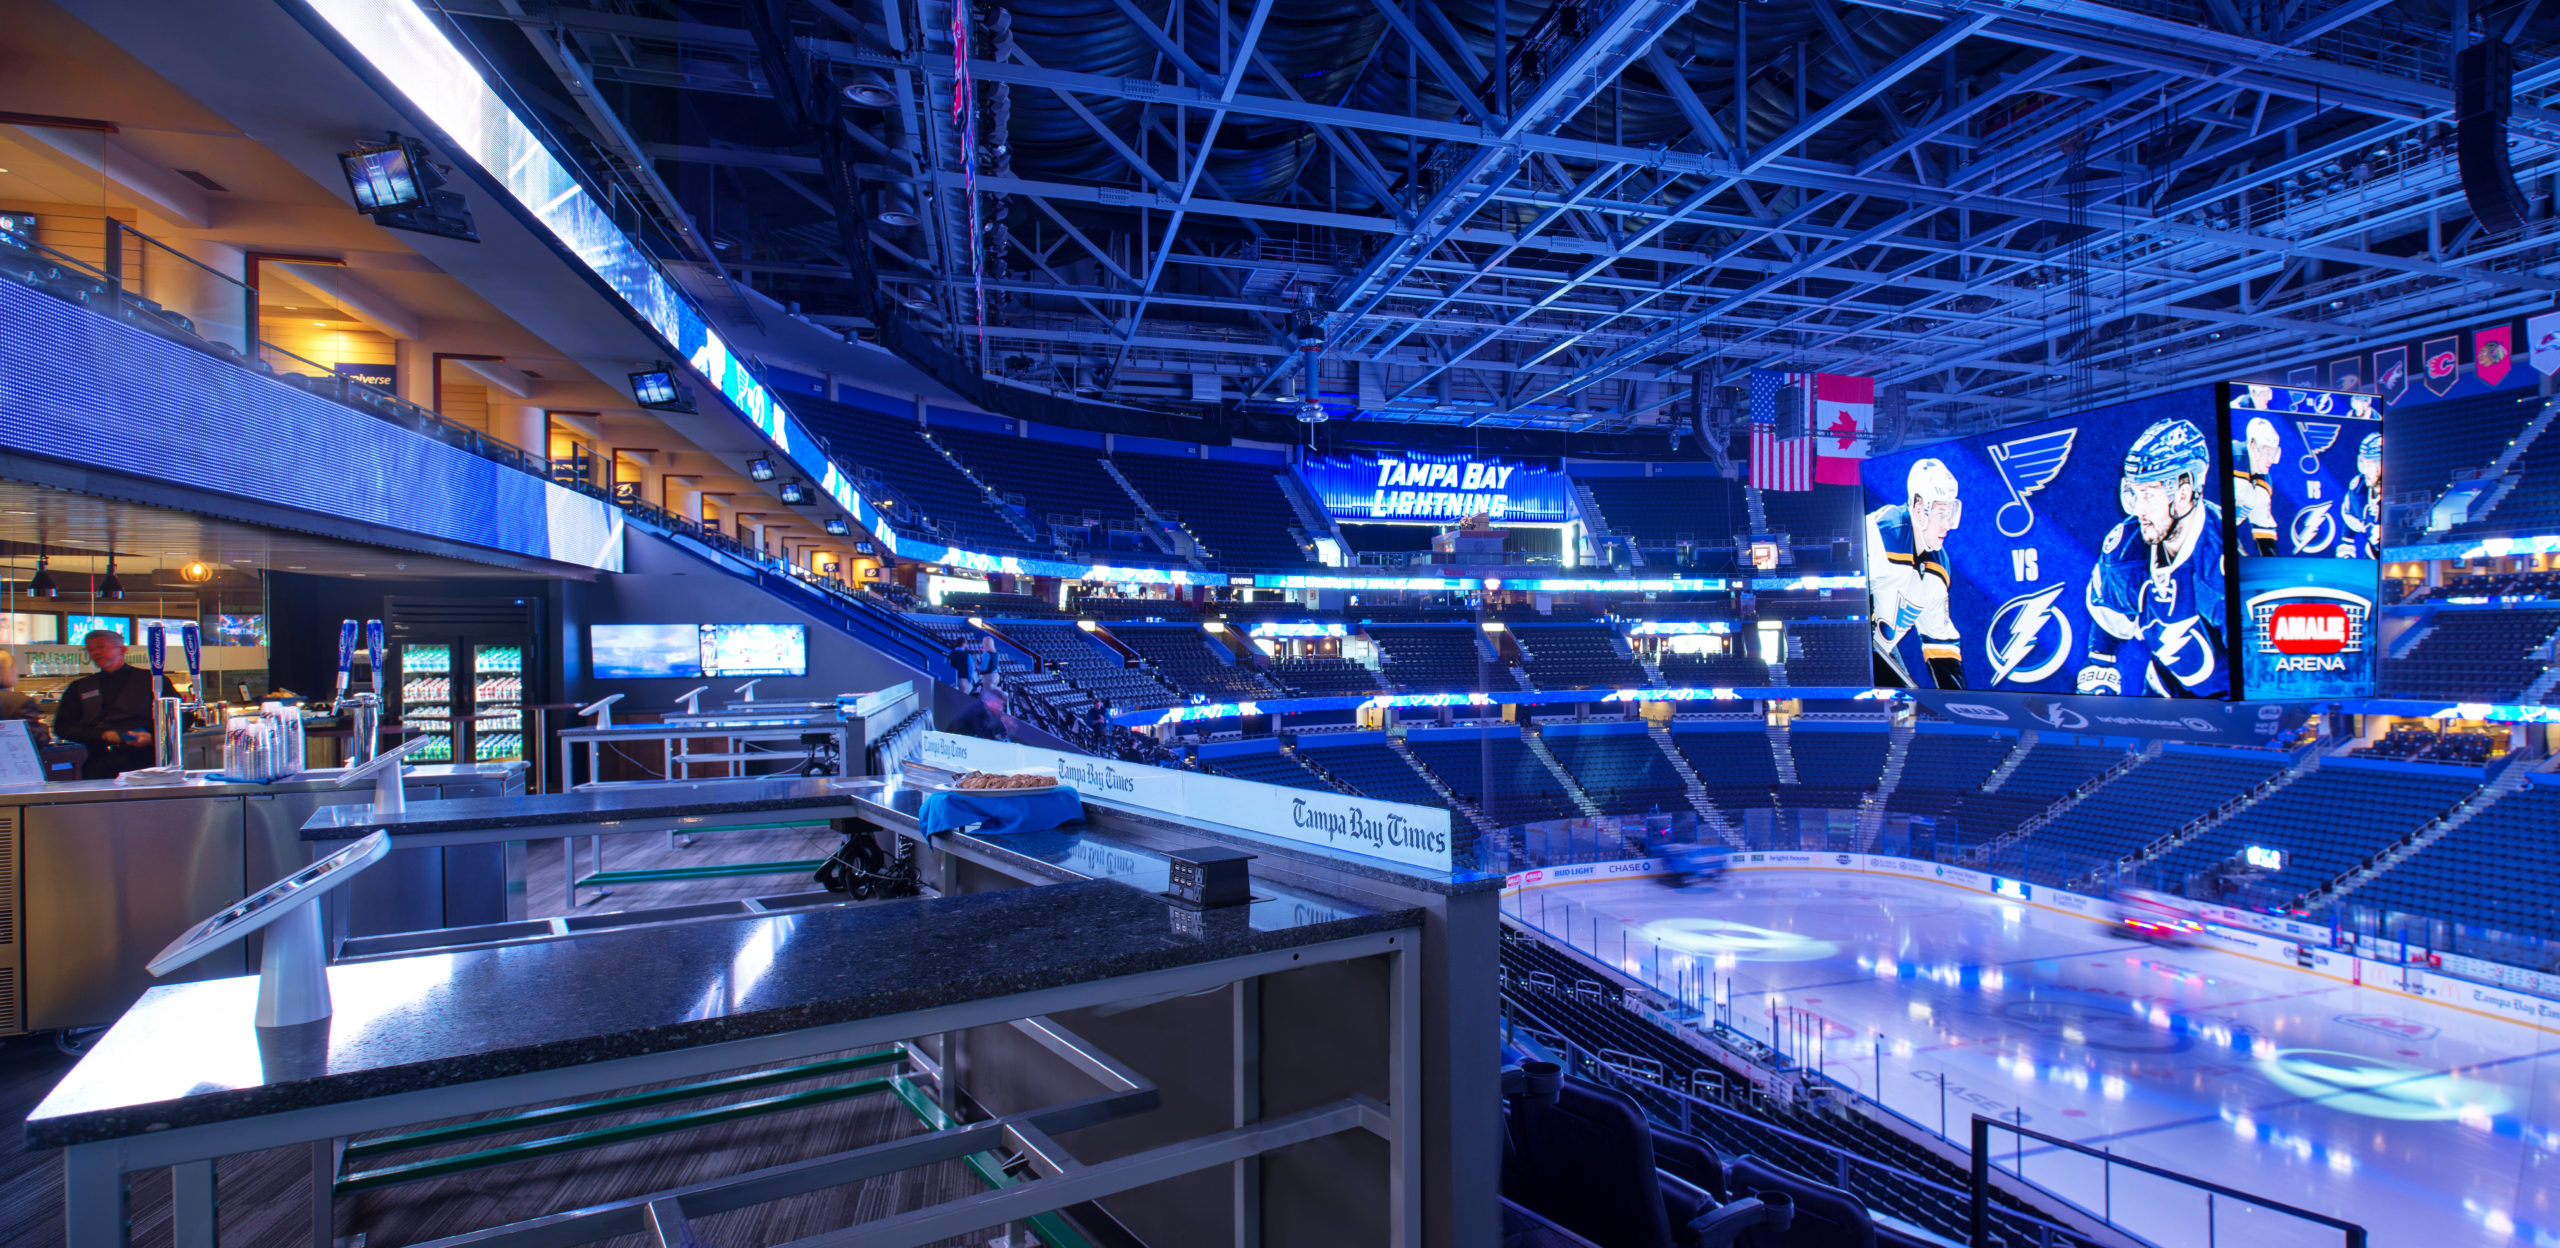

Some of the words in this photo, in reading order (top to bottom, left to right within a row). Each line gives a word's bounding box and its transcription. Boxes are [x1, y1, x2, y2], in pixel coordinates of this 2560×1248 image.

[1377, 459, 1458, 488] TAMPA
[1461, 463, 1514, 490] BAY
[1371, 490, 1508, 518] LIGHTNING
[2011, 549, 2039, 582] VS
[2275, 616, 2345, 643] AMALIE
[2275, 657, 2346, 671] ARENA
[924, 736, 940, 758] Tampa
[940, 738, 951, 759] Bay
[951, 740, 967, 759] Times
[1058, 757, 1086, 788] Tampa
[1086, 762, 1104, 791] Bay
[1105, 766, 1134, 793] Times
[1292, 797, 1347, 842] Tampa
[1350, 806, 1384, 848] Bay
[1387, 813, 1446, 853] Times
[1554, 868, 1570, 877] BUD
[1572, 867, 1594, 875] LIGHT
[1609, 863, 1640, 873] CHASE
[2473, 989, 2511, 1008] Tampa
[2513, 999, 2536, 1015] Bay
